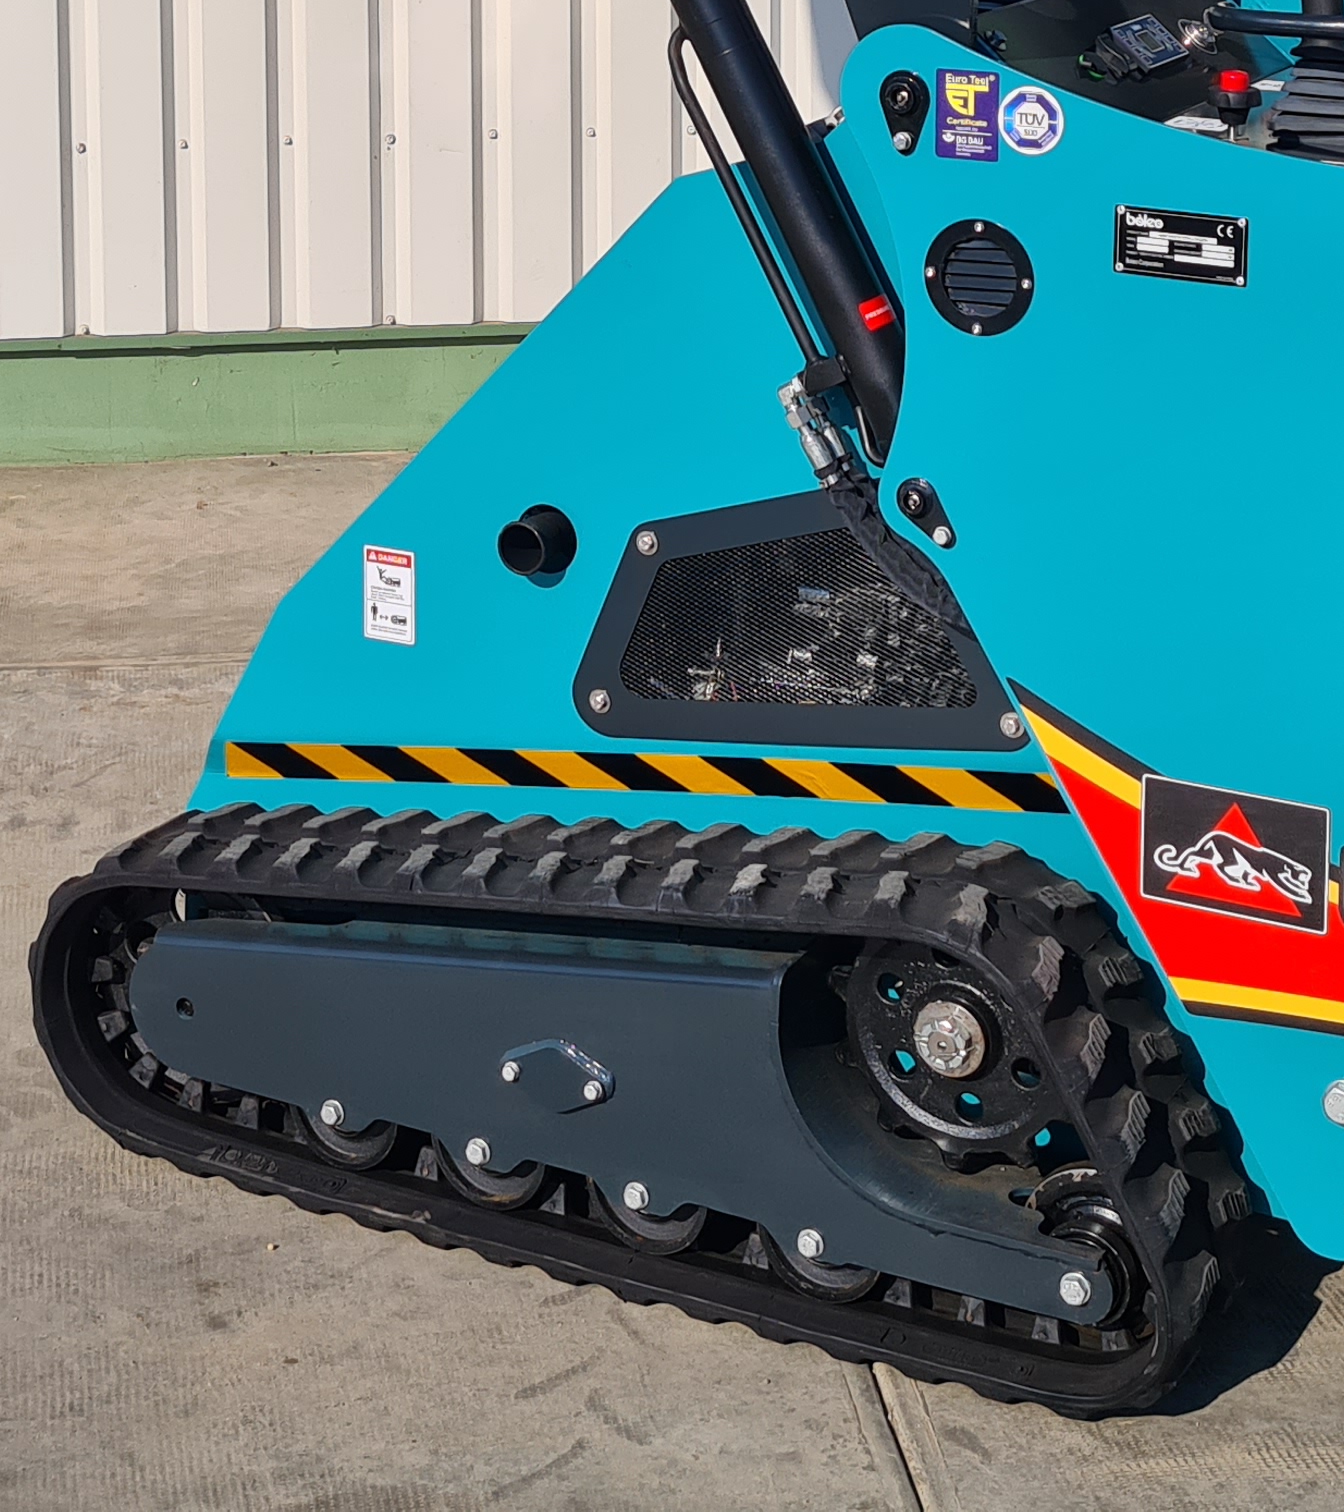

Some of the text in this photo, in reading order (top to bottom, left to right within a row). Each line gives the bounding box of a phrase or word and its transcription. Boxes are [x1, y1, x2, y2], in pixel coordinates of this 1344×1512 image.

[945, 73, 968, 84] Euro
[1017, 112, 1045, 126] TÜV
[1216, 224, 1234, 238] CE
